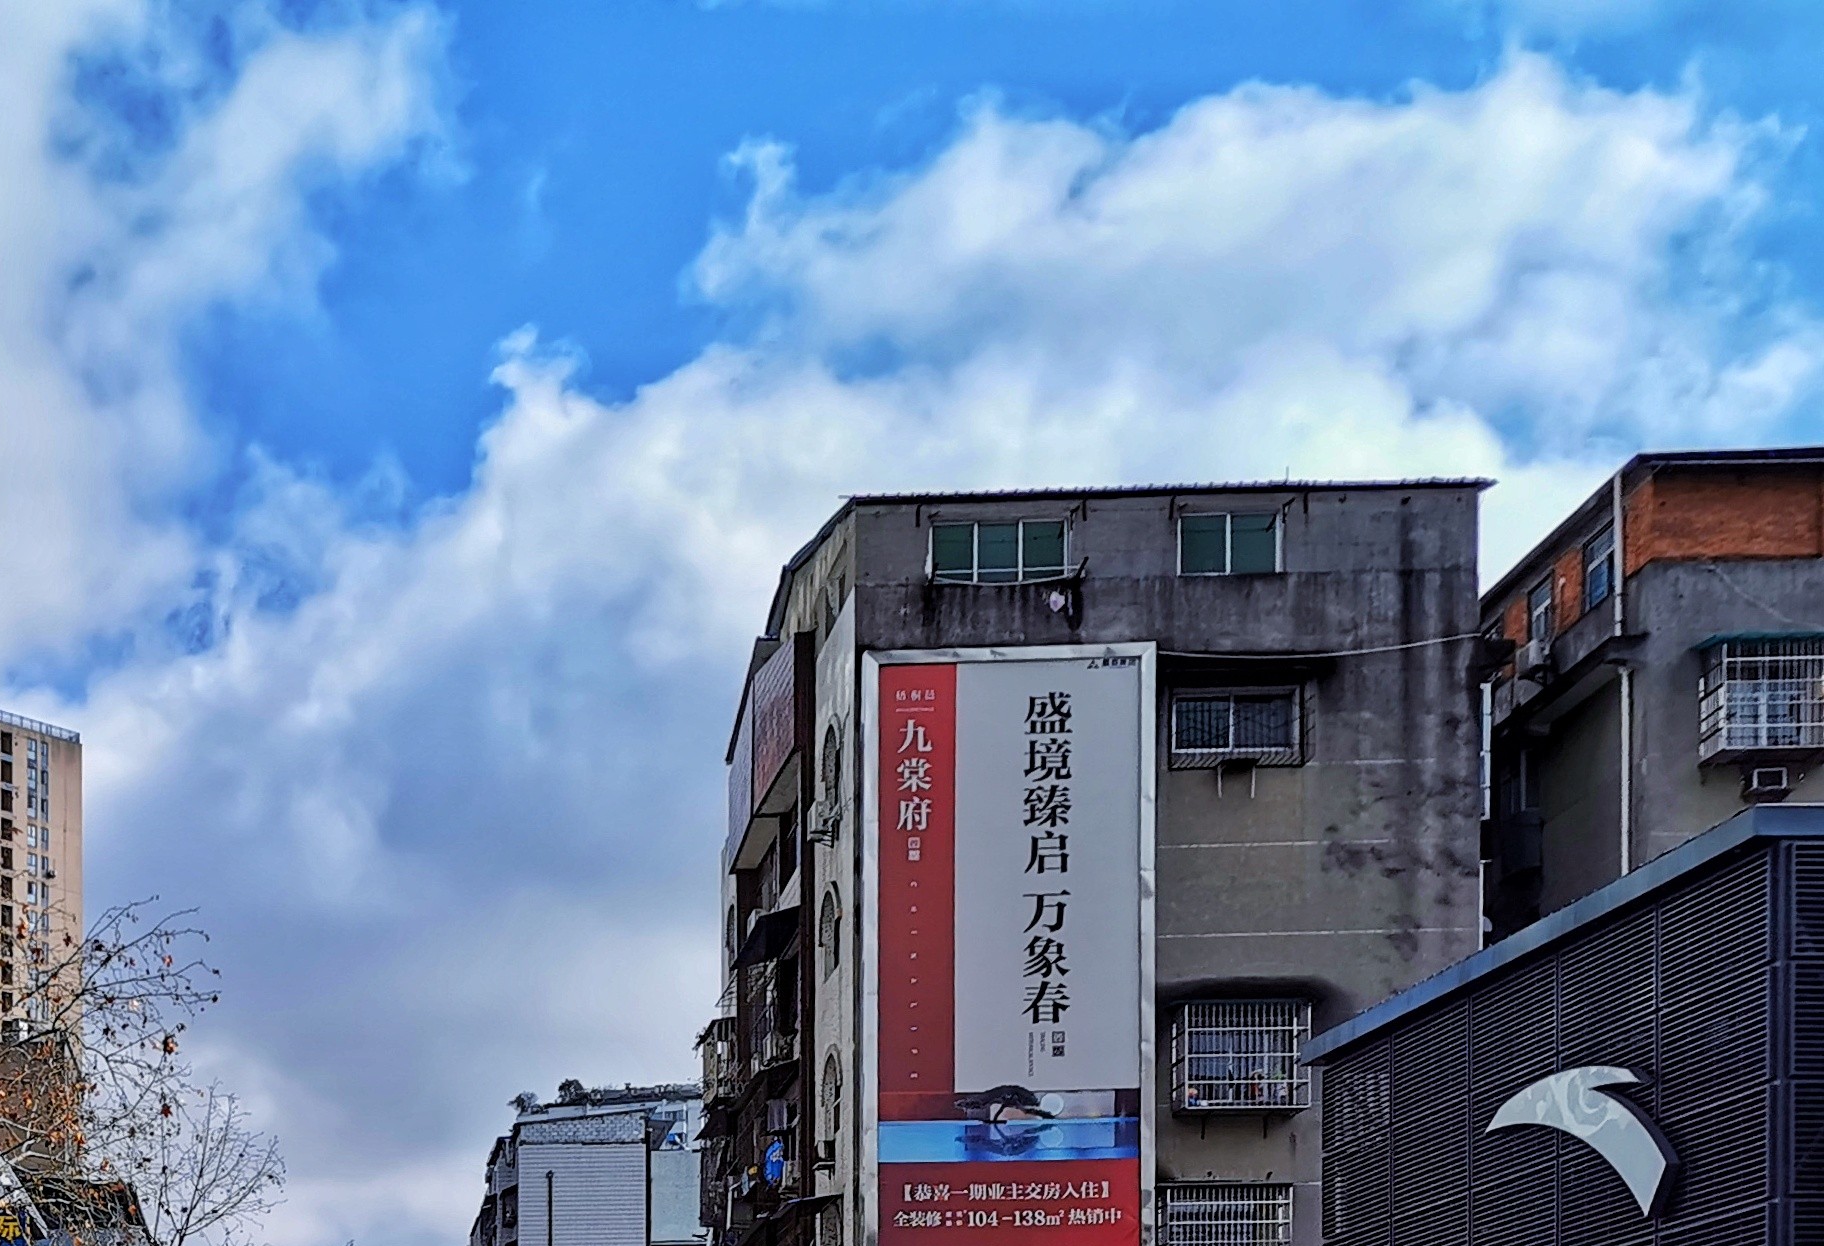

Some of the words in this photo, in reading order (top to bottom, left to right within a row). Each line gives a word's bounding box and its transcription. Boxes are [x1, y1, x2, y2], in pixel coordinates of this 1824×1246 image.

[897, 719, 933, 831] 九棠府
[893, 1211, 941, 1228] 全装修
[1068, 1207, 1121, 1226] 热销中
